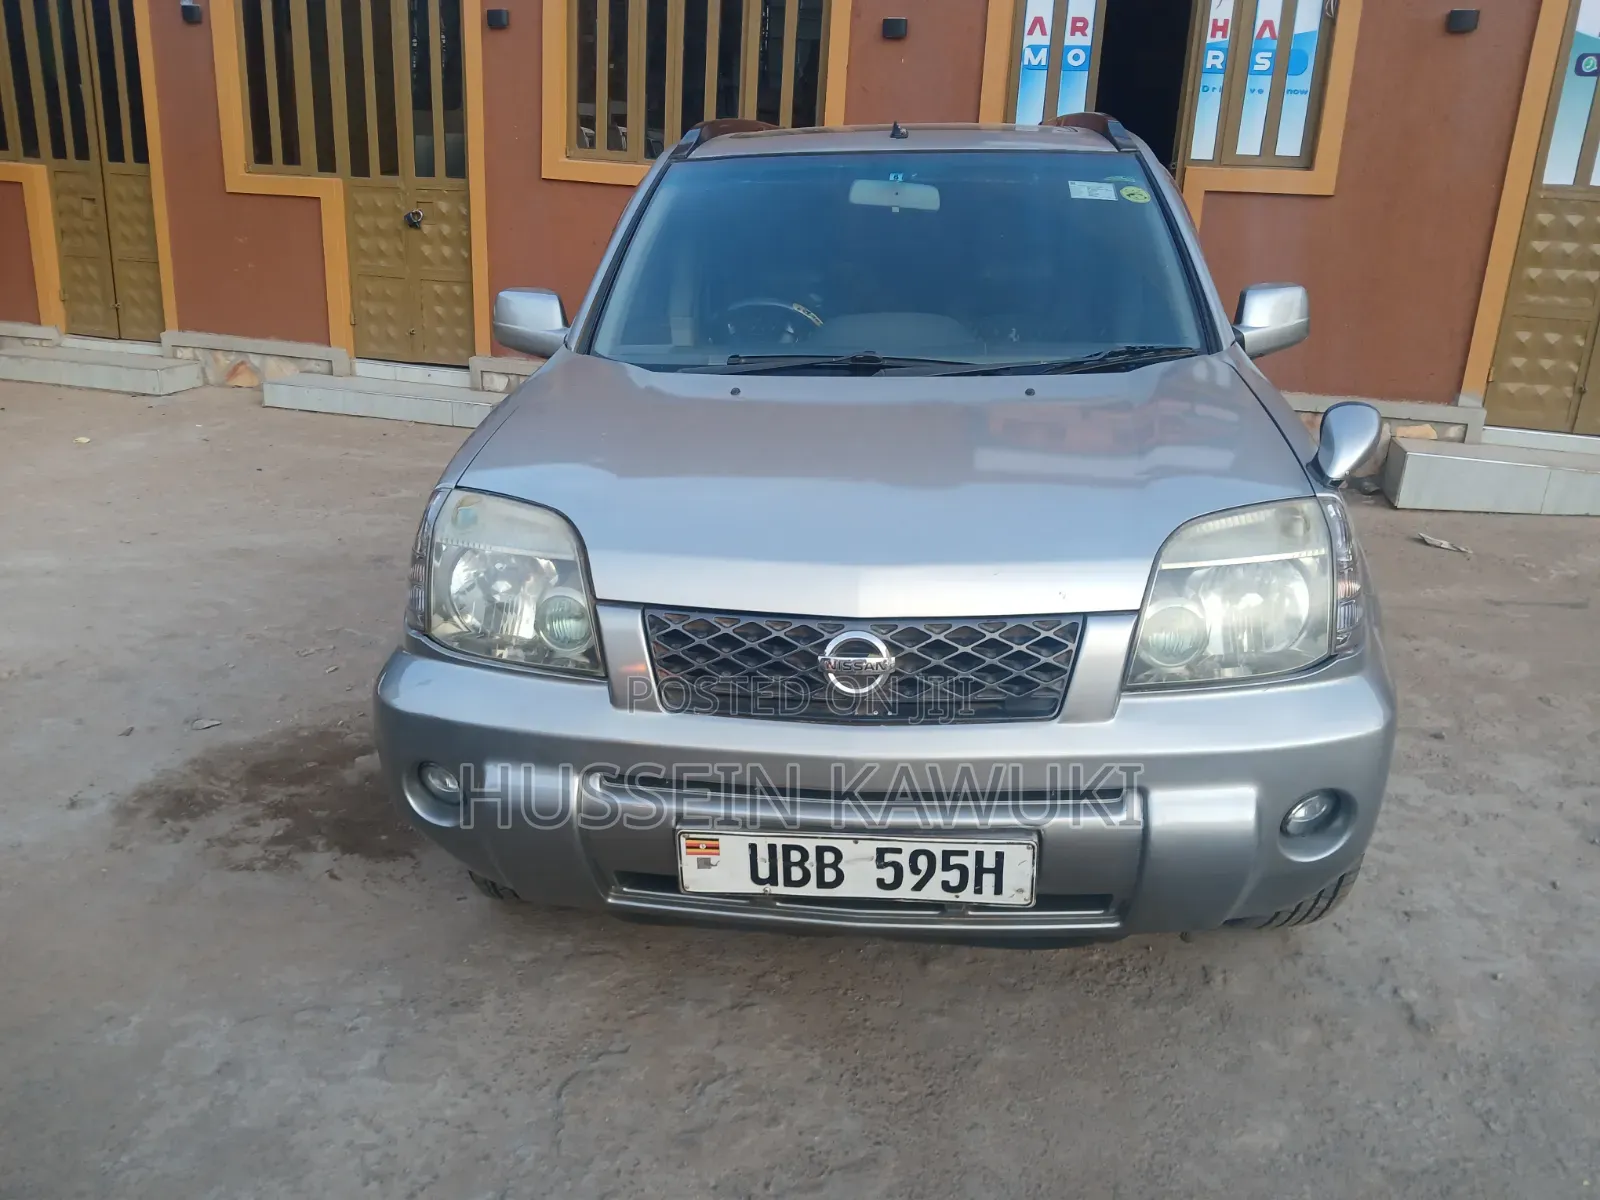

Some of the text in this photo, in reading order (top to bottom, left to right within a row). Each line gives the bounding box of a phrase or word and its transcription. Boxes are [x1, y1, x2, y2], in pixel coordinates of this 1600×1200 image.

[825, 658, 887, 671] NISSAN
[748, 842, 1005, 896] UBB 595H
